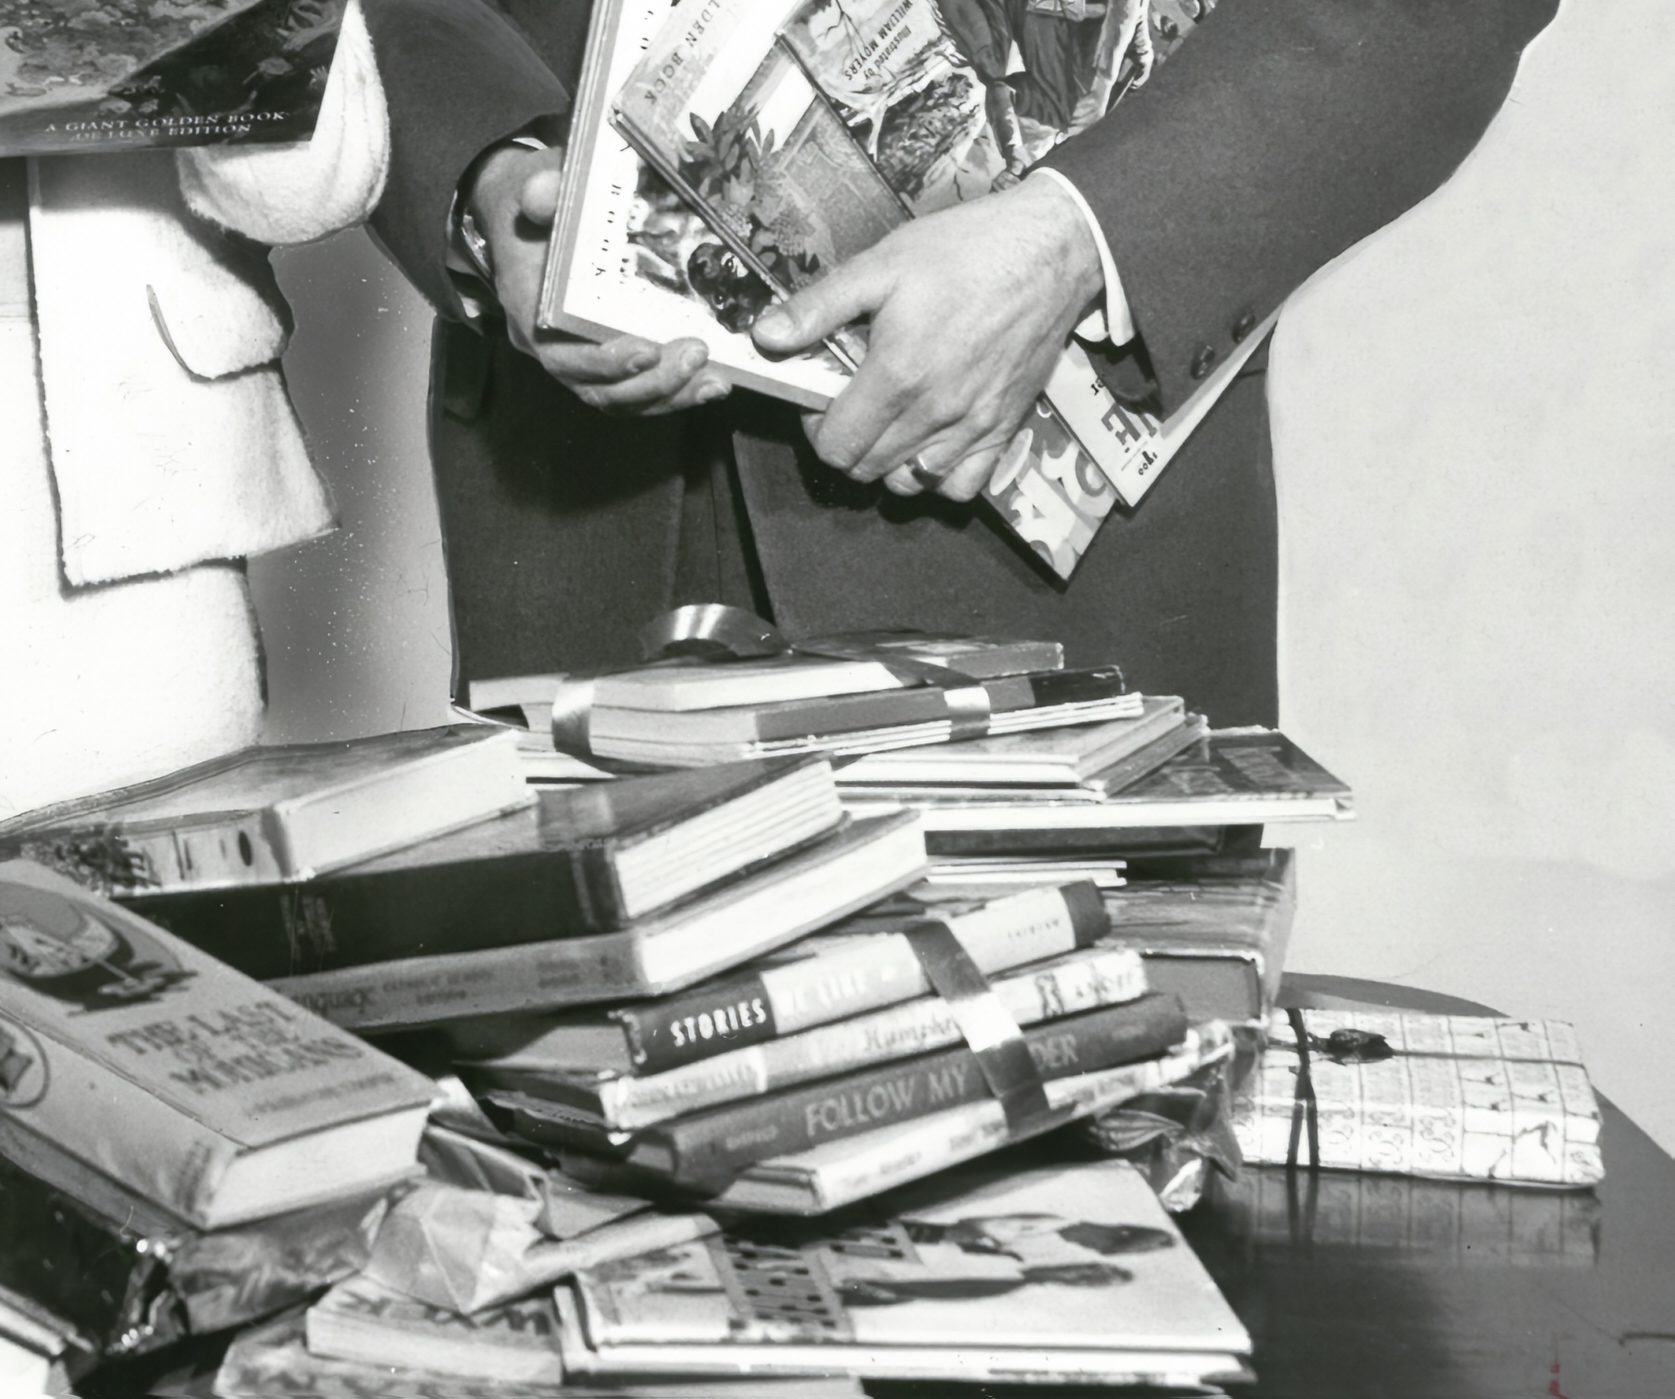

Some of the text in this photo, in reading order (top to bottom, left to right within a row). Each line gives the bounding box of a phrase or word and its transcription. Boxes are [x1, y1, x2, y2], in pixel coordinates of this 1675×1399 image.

[844, 38, 879, 81] MOYERS
[863, 24, 912, 80] Illustrated by
[643, 51, 685, 106] BOOK
[45, 110, 290, 132] A GIANT GOLDEN BOOK
[168, 123, 252, 135] EDITION
[669, 997, 768, 1048] STORIES
[803, 1075, 917, 1138] FOLLOW
[926, 1060, 971, 1103] MY
